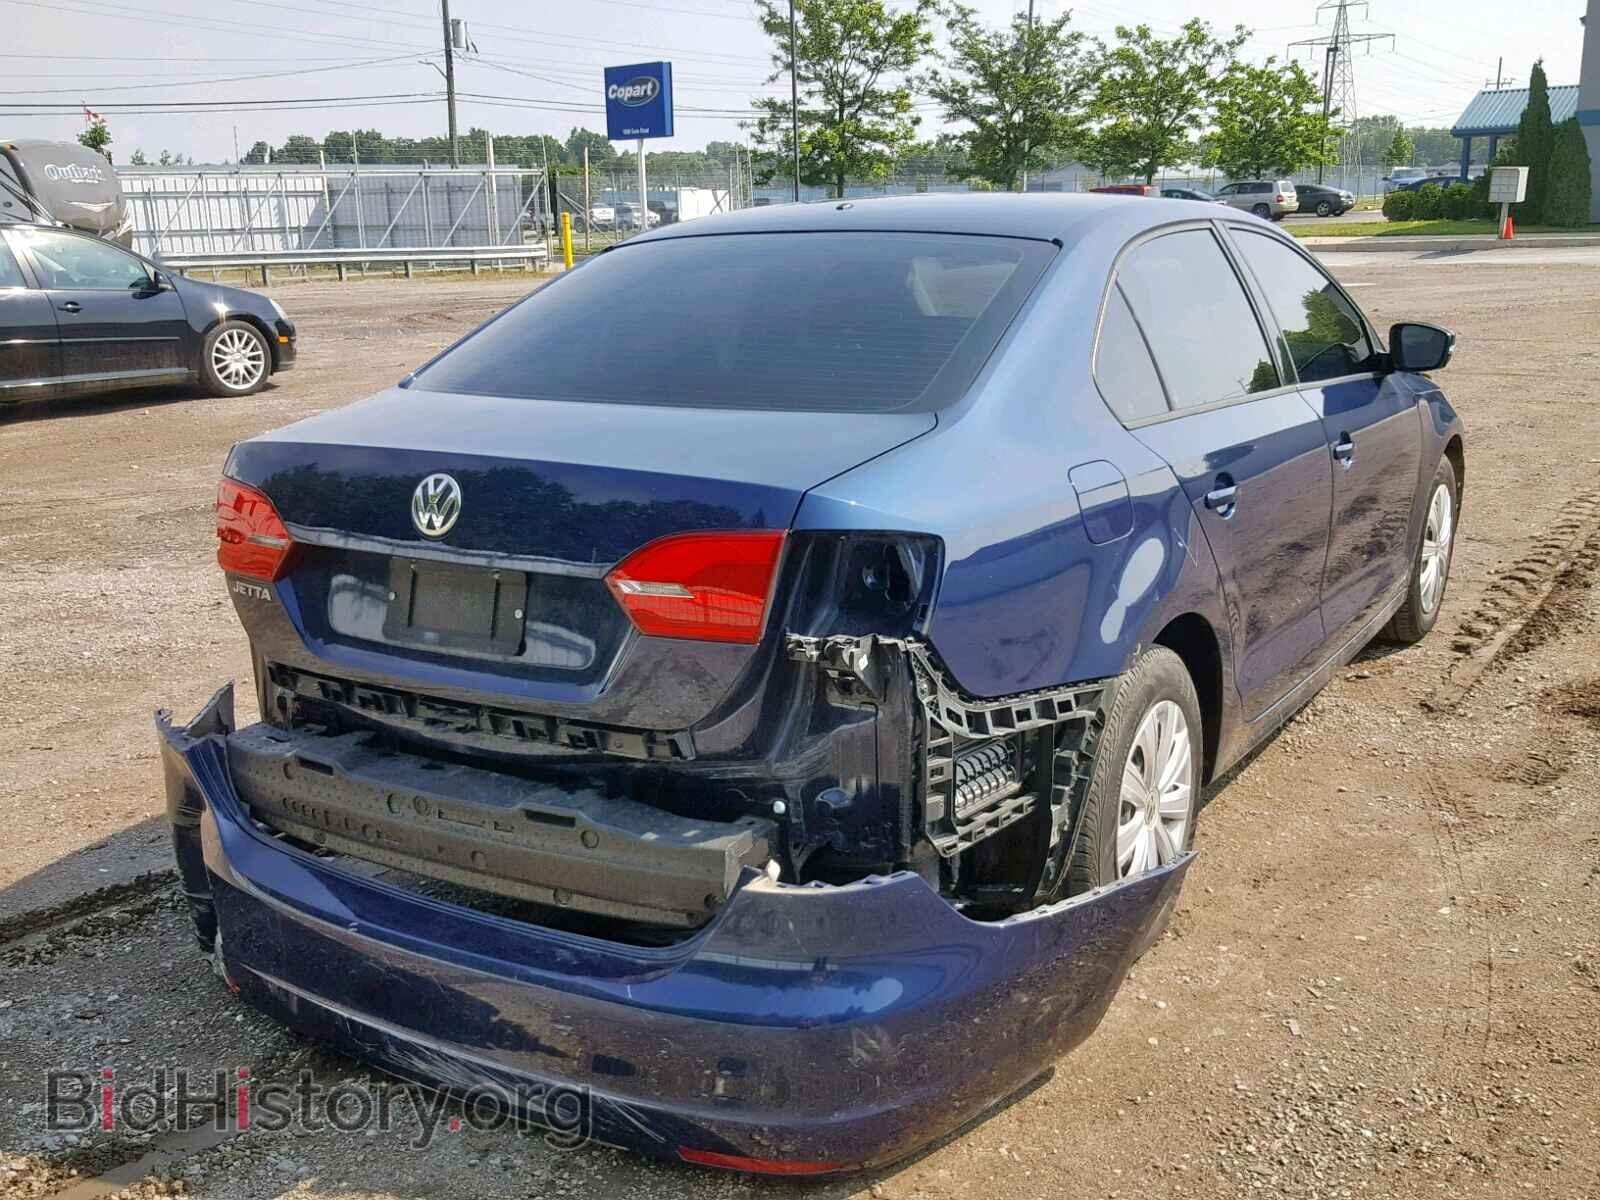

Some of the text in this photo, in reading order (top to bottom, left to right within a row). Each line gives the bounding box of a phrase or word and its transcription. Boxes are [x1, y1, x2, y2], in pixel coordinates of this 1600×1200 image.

[608, 80, 654, 101] Copart
[411, 473, 461, 536] VW
[232, 580, 271, 601] JETTA
